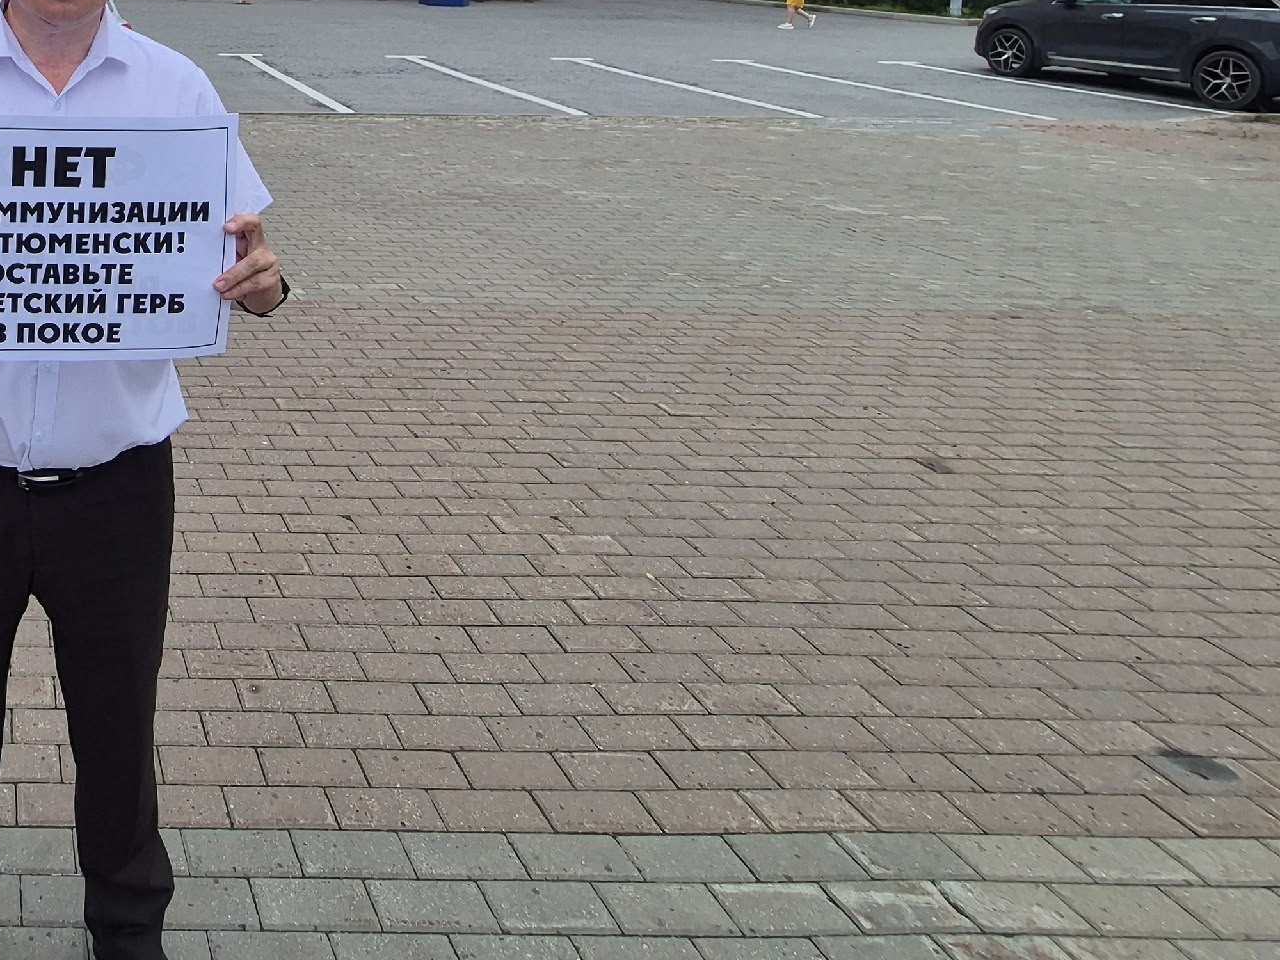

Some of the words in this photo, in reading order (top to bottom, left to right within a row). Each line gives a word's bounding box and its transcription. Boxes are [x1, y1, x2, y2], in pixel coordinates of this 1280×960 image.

[11, 146, 117, 189] НЕТ
[116, 292, 186, 314] ГЕРБ
[16, 322, 122, 344] ПОКОЕ
